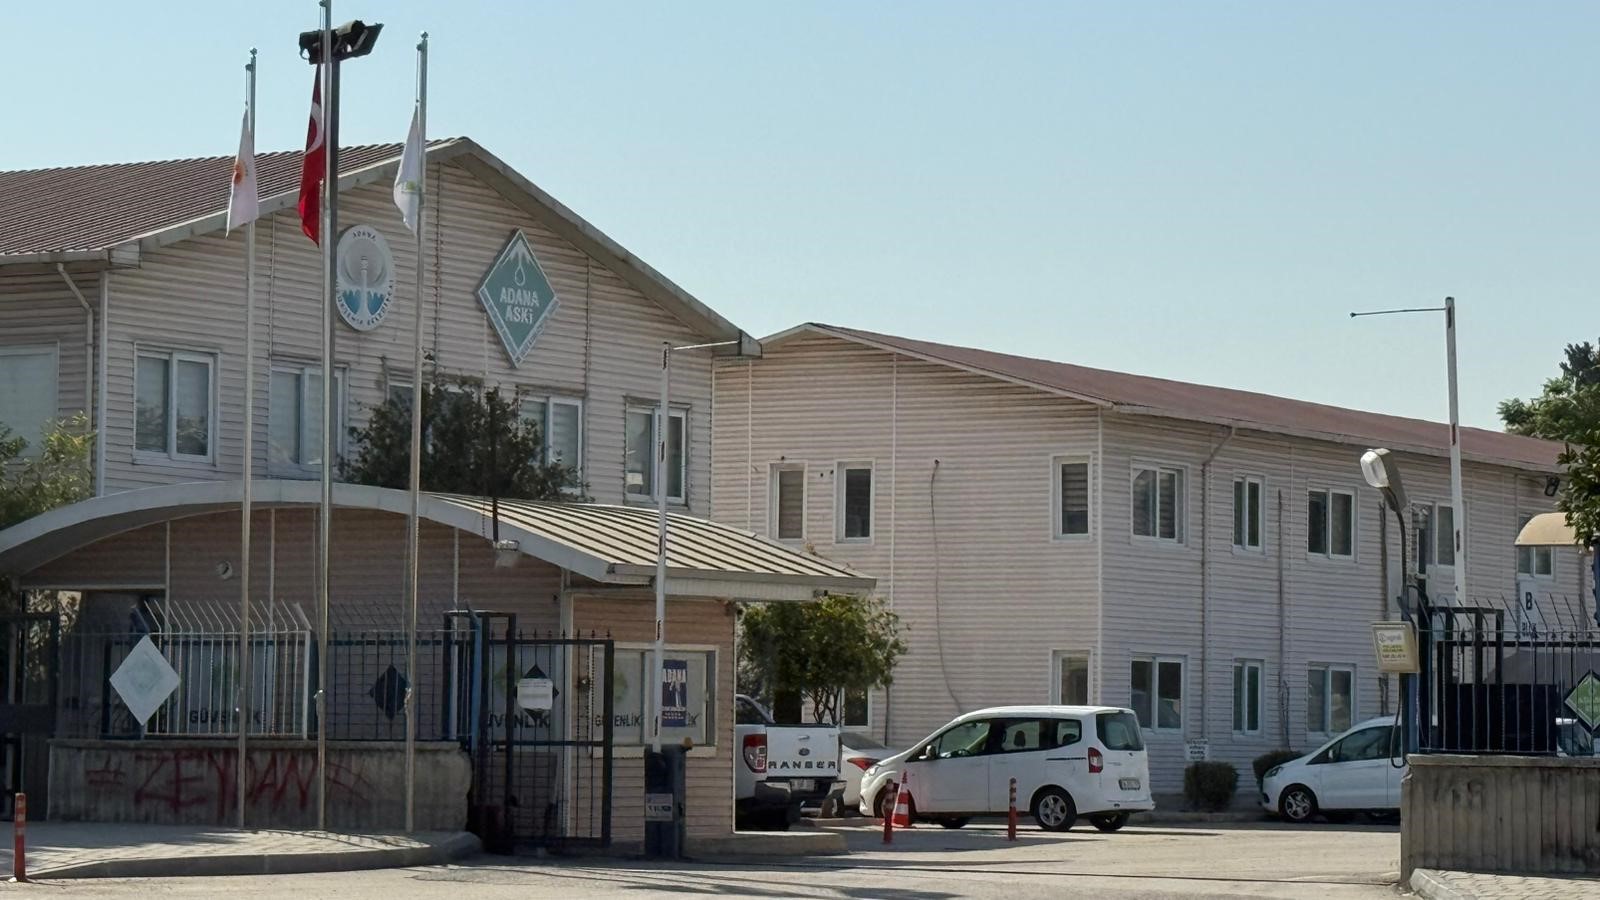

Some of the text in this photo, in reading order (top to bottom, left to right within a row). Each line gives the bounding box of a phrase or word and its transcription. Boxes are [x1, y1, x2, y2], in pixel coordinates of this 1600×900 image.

[499, 287, 540, 308] ADANA
[1525, 591, 1533, 610] B
[594, 712, 644, 727] GENLİK
[767, 760, 836, 770] RANGER
